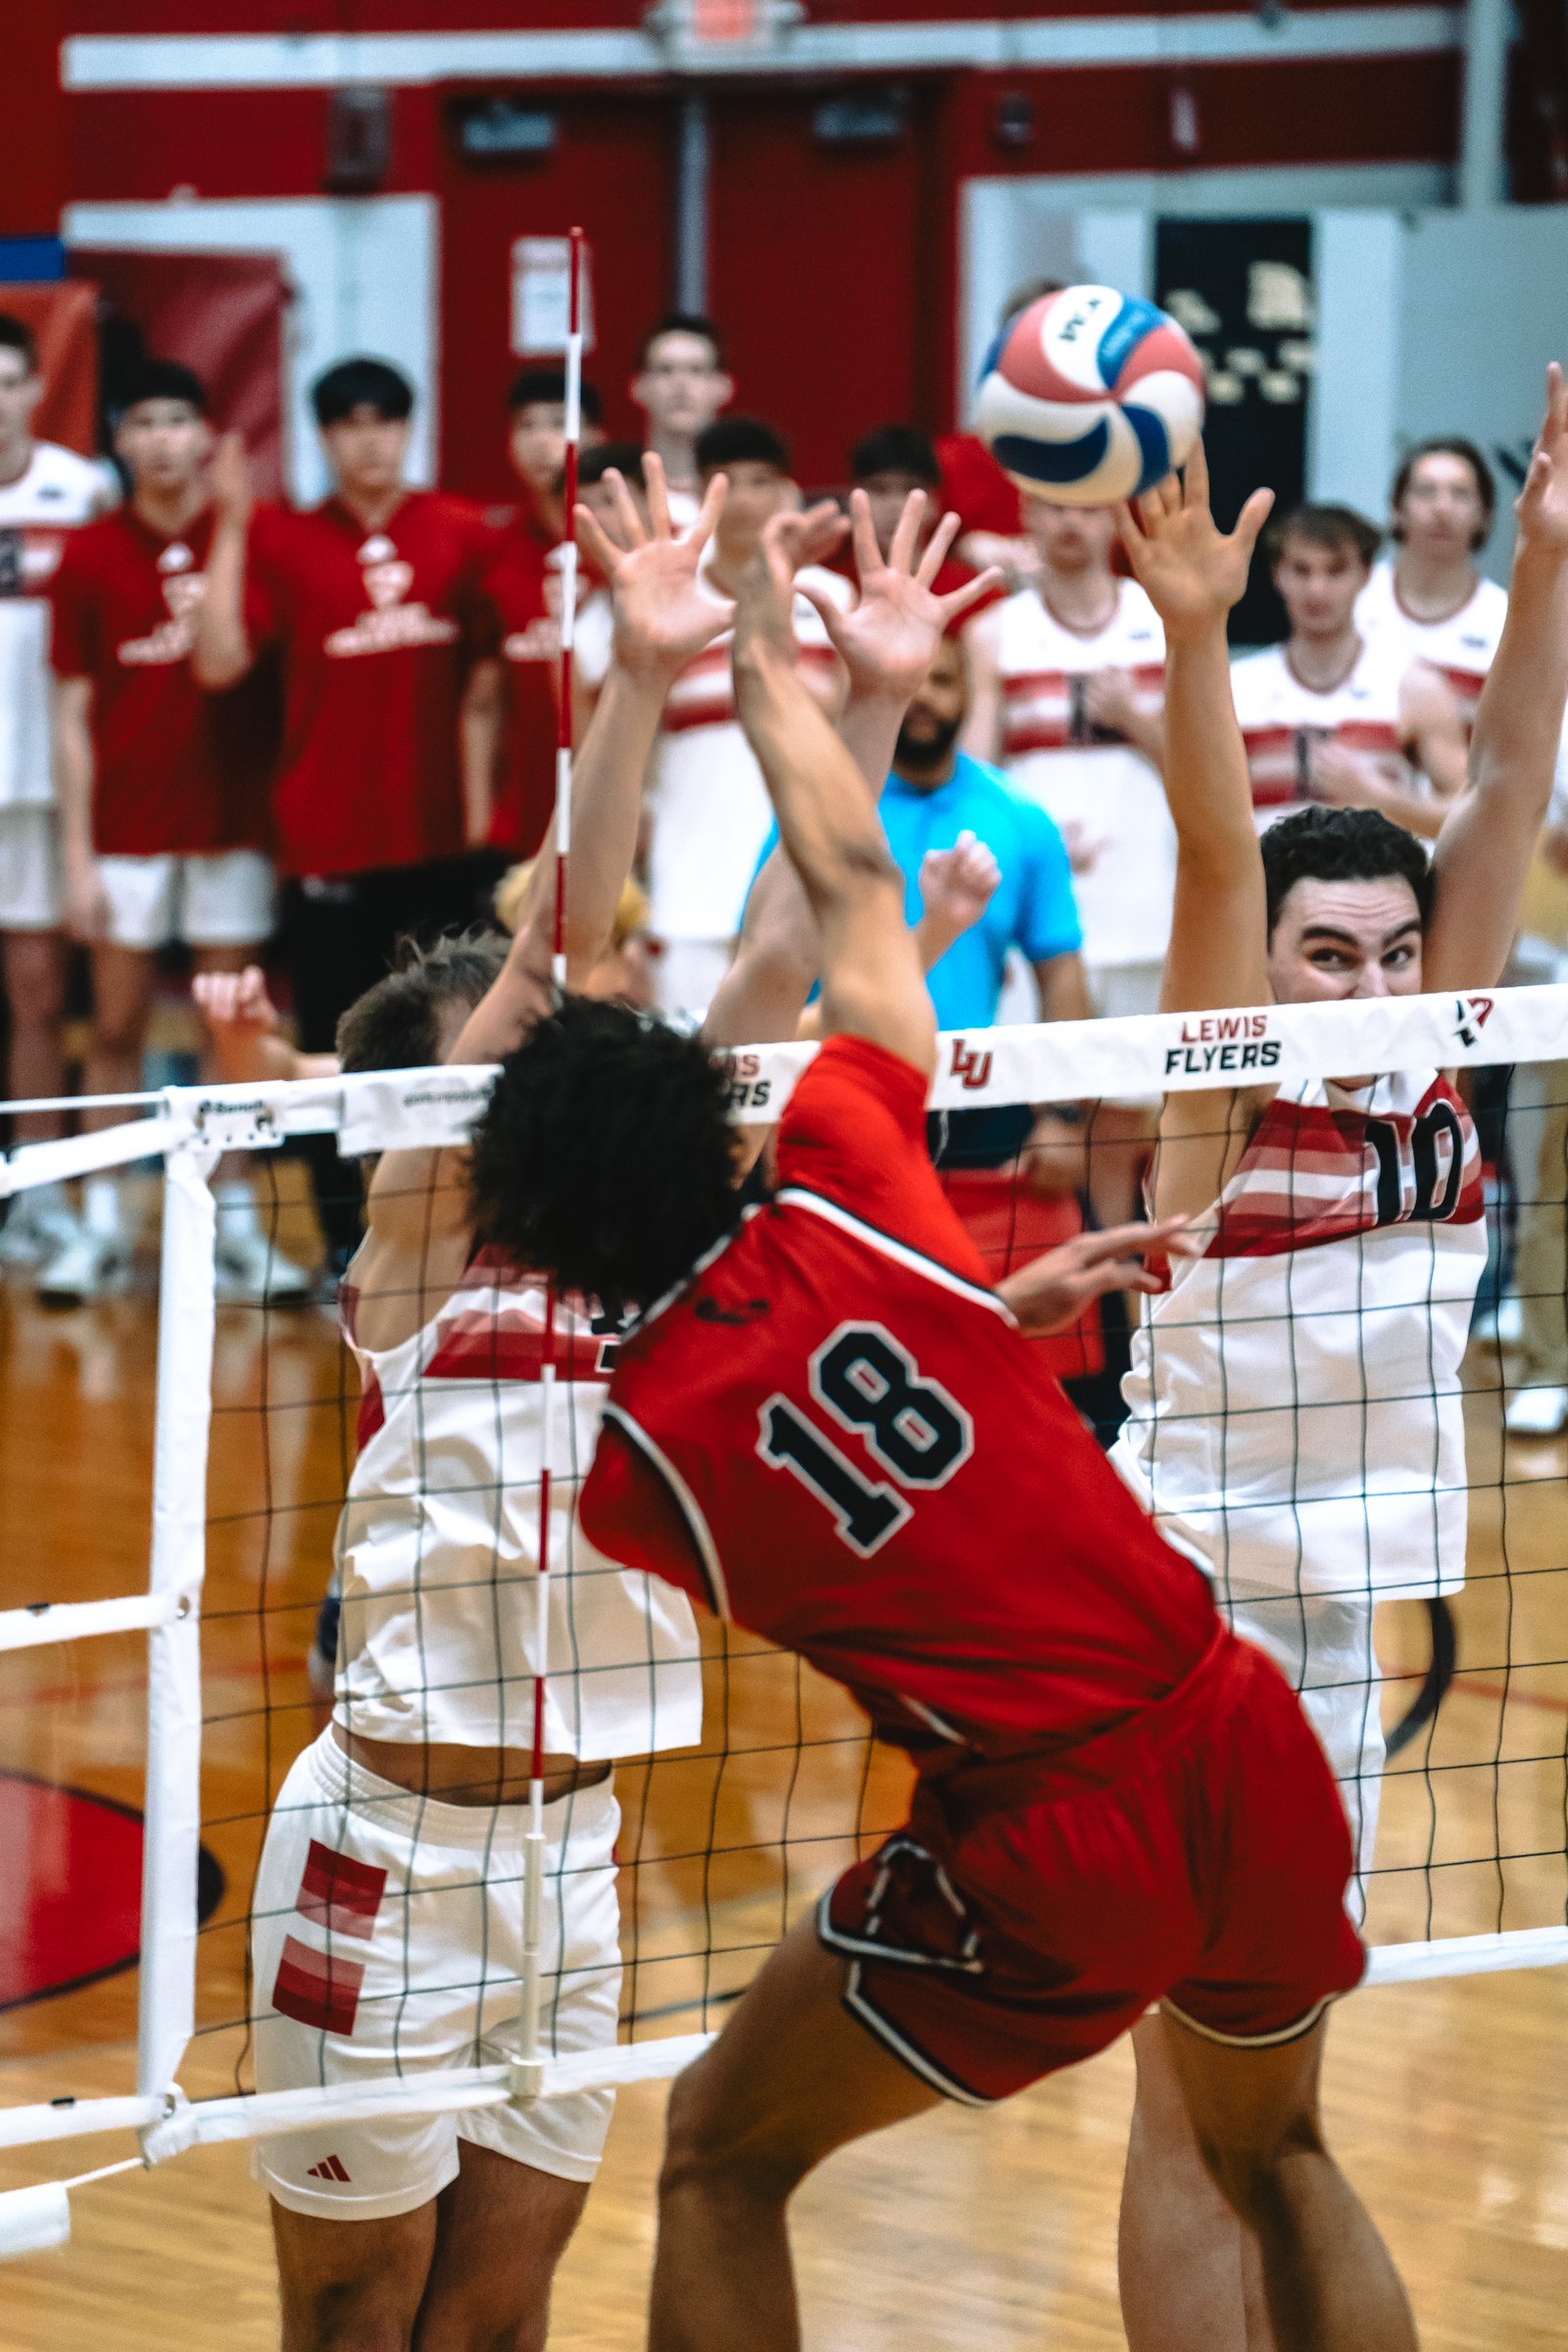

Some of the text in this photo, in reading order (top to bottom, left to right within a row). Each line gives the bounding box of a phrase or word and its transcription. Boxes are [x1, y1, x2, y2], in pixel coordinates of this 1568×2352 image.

[1181, 1014, 1267, 1044] LEWIS
[951, 1039, 994, 1089] LU
[1164, 1040, 1282, 1075] FLYERS
[1363, 1098, 1465, 1225] 10
[755, 1320, 975, 1559] 18
